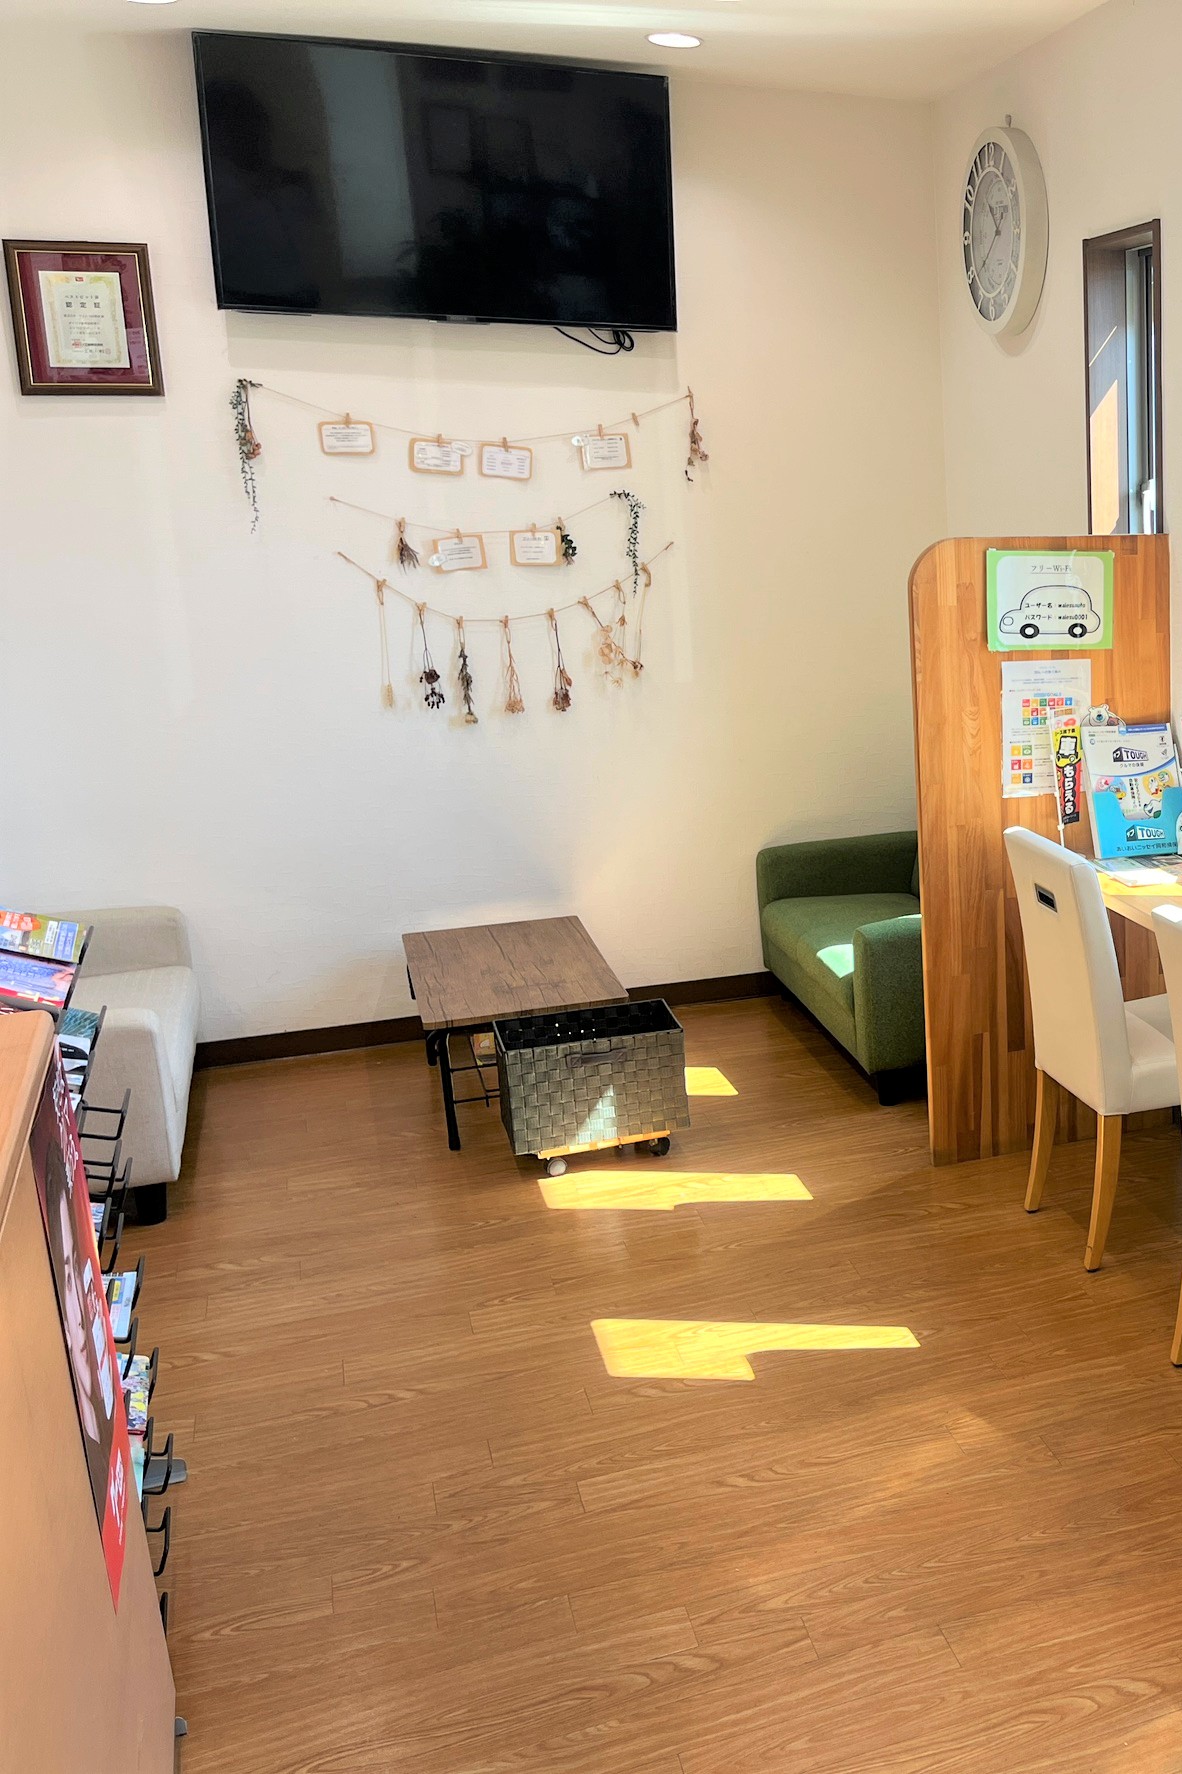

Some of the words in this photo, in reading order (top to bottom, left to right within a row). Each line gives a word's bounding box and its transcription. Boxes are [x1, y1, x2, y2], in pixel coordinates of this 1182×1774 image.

[1124, 750, 1148, 759] TOUGH
[1063, 764, 1076, 815] もらえる
[1141, 828, 1165, 838] TOUGH
